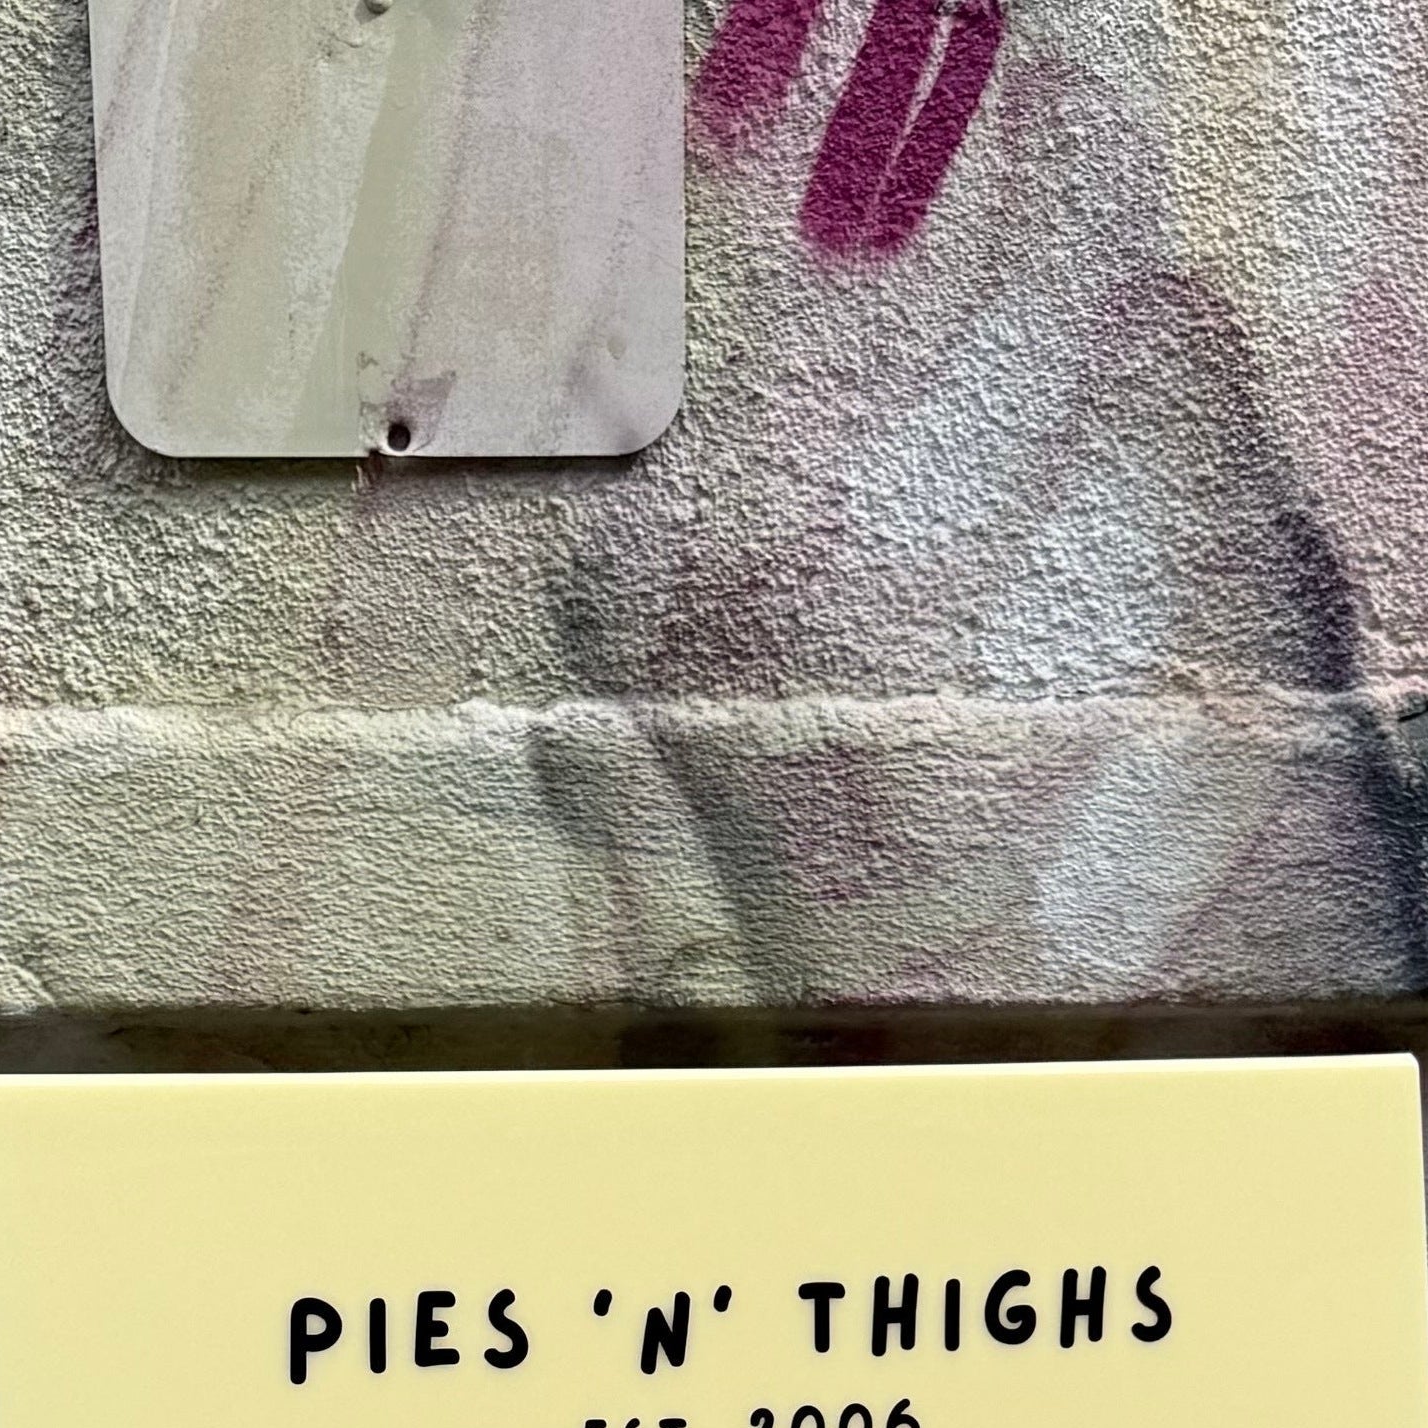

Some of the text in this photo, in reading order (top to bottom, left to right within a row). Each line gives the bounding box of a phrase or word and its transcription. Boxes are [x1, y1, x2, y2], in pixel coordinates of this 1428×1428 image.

[290, 1266, 1171, 1384] PIES 'N' THIGHS
